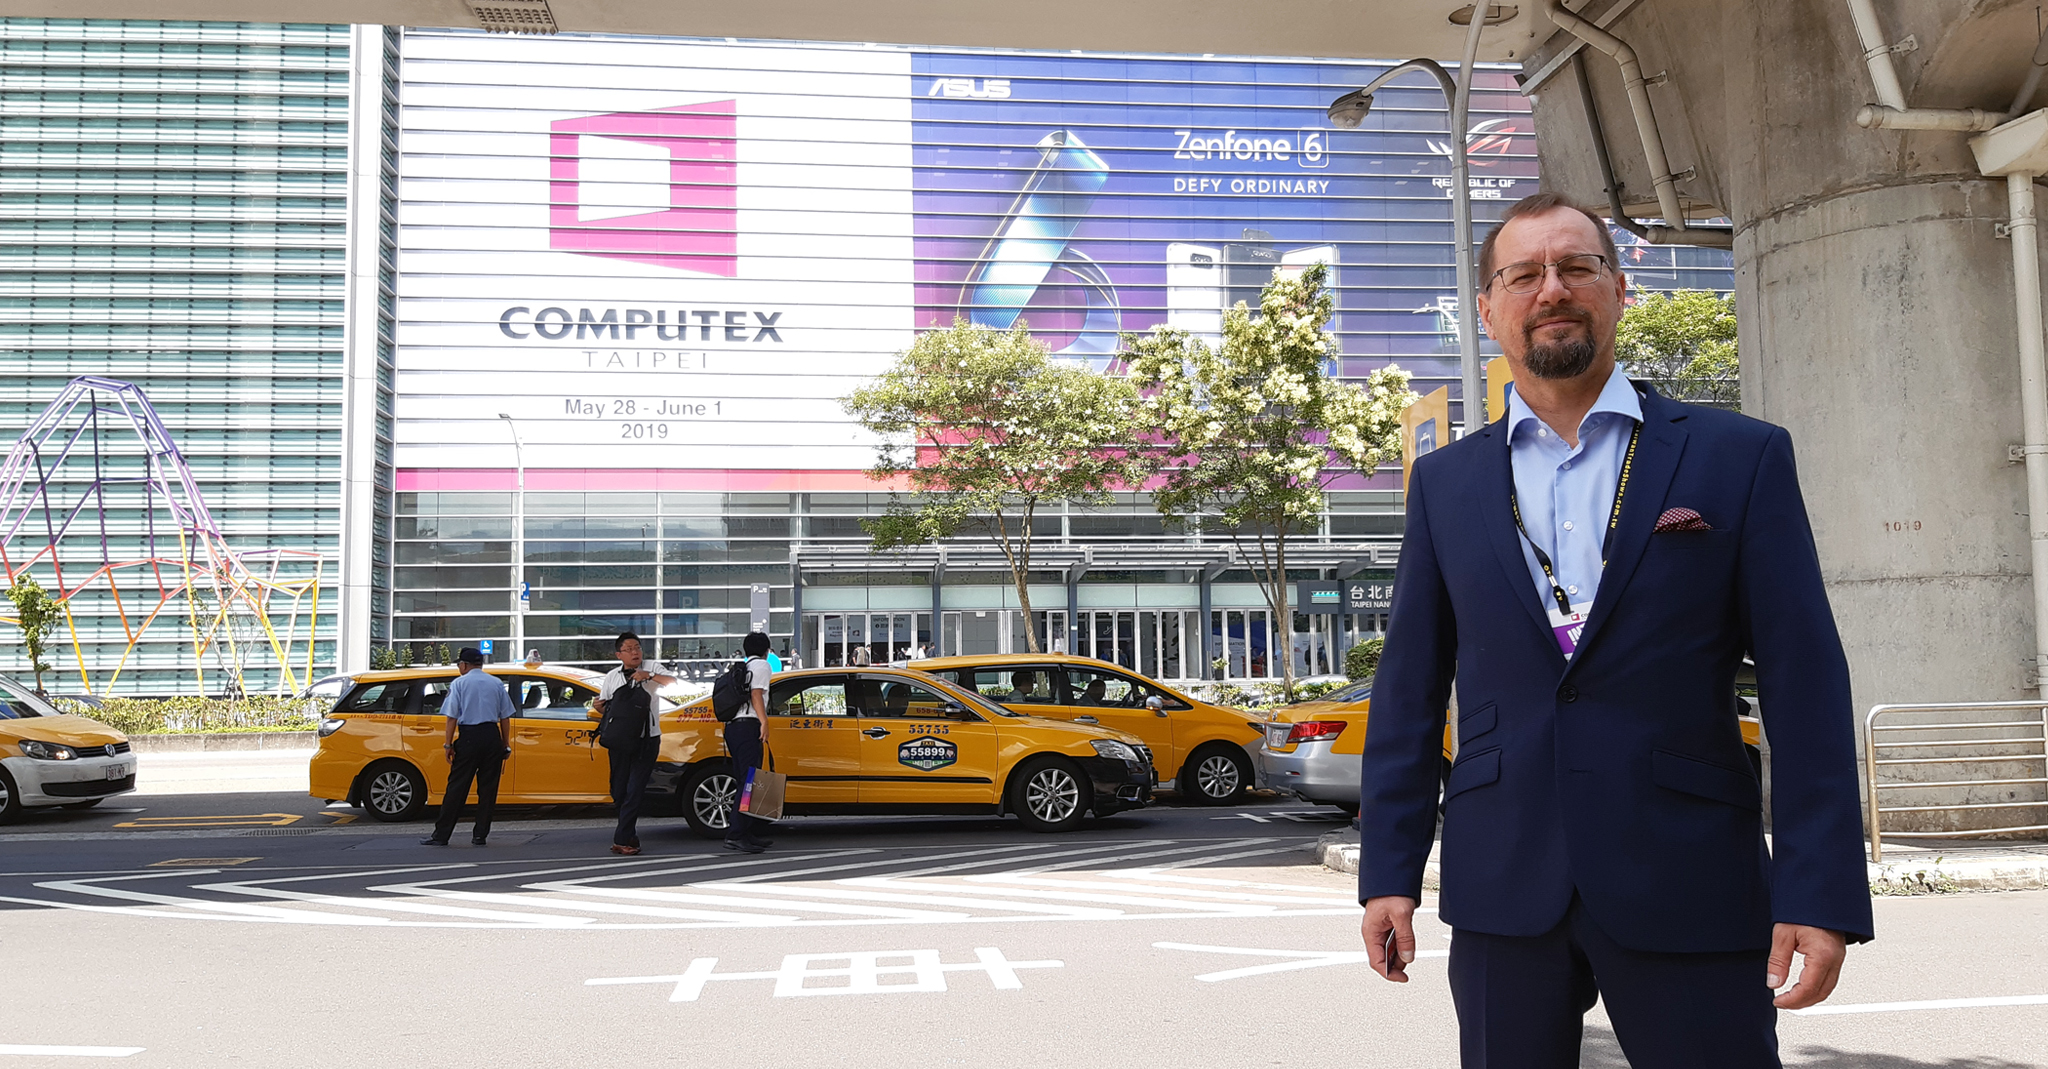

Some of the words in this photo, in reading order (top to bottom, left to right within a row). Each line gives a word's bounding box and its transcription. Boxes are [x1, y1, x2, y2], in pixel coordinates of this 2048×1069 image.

[928, 78, 1012, 99] ASUS
[1173, 130, 1292, 161] Zenfone
[1173, 178, 1223, 194] DEFY
[1230, 178, 1331, 195] ORDINARY
[1432, 178, 1496, 189] REBLIC
[1498, 178, 1516, 188] OF
[499, 306, 785, 343] COMPUTEX
[582, 350, 708, 369] TAIPEI
[565, 398, 605, 419] May
[613, 399, 637, 416] 28
[655, 399, 706, 417] June
[714, 399, 722, 416] 1
[620, 423, 669, 439] 2019
[1350, 600, 1372, 608] TAIPEI
[1373, 600, 1391, 608] NAN
[684, 706, 709, 715] 55755
[909, 724, 949, 735] 55755
[910, 747, 945, 757] 55899
